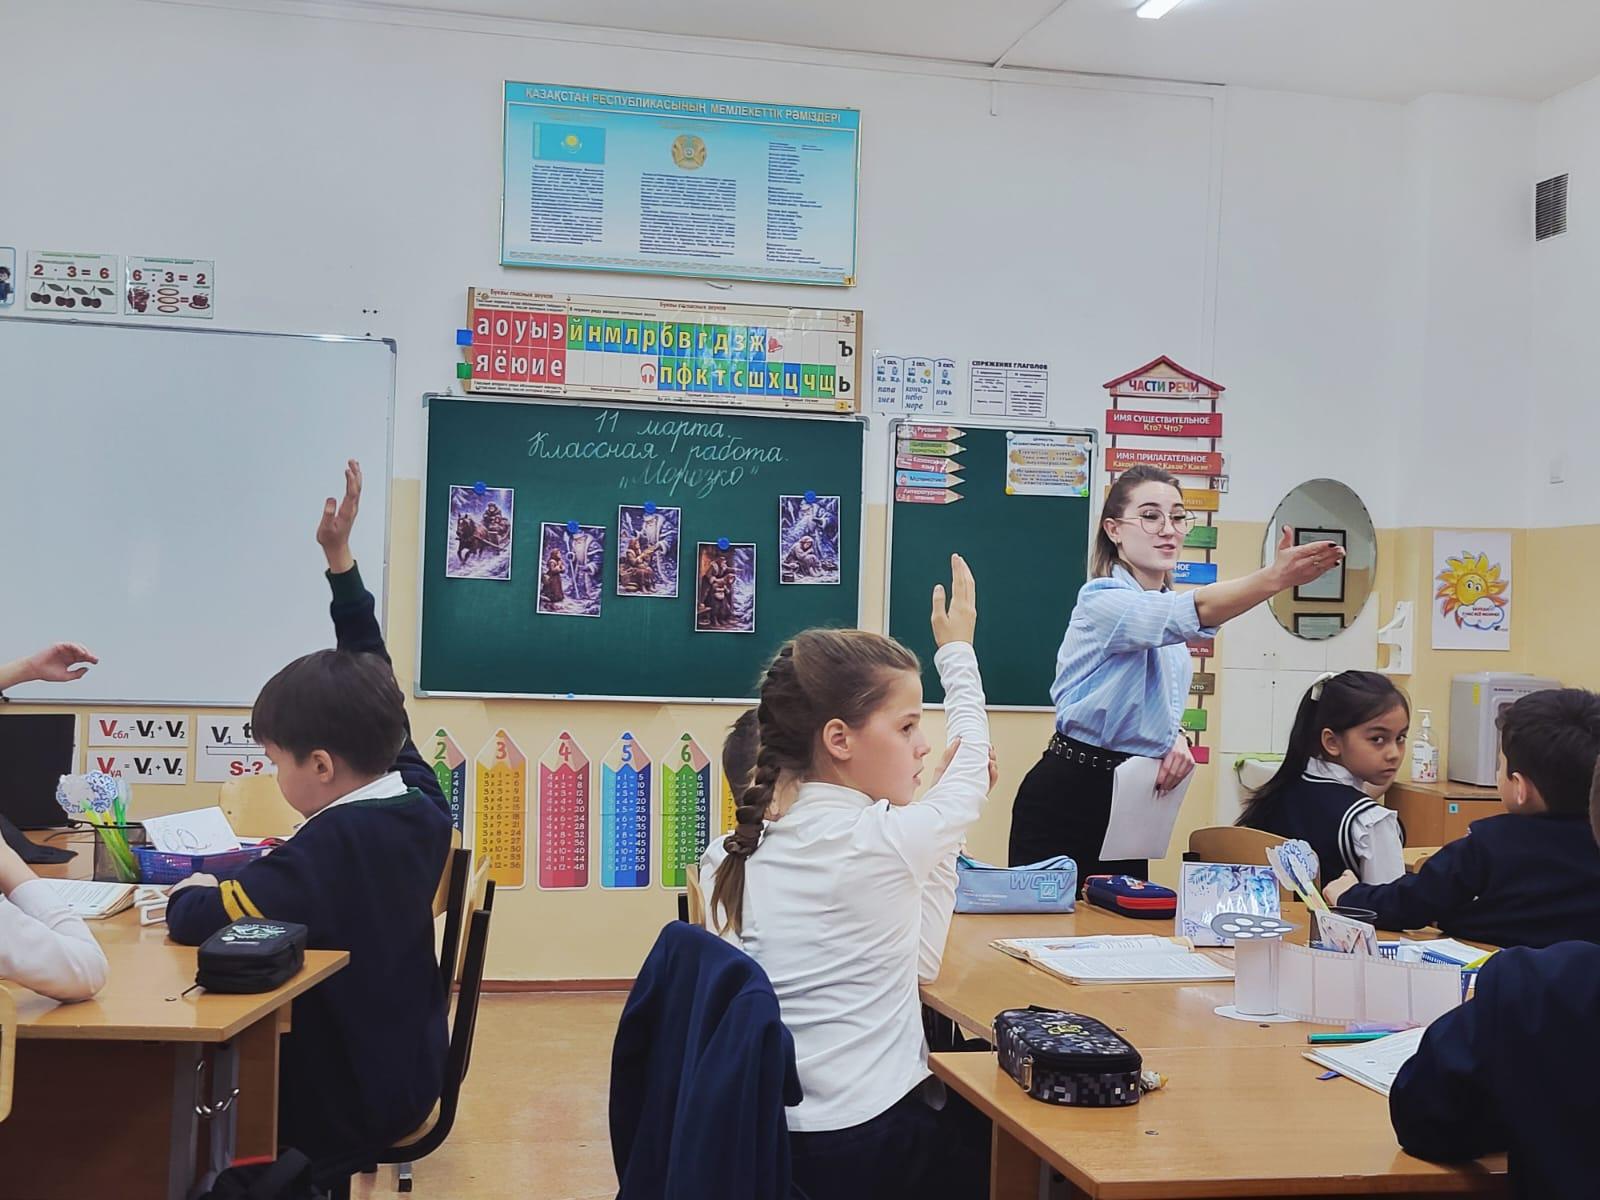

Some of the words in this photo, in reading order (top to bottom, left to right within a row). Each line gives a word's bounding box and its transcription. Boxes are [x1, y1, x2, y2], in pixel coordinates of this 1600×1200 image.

[592, 94, 706, 113] РЕСПУБЛИКАСЫНЫҢ
[711, 103, 783, 119] МЕМЛЕКЕТТІК
[785, 110, 840, 123] РӘМІЗДЕРІ
[34, 264, 44, 276] 2
[66, 266, 77, 277] 3
[100, 268, 110, 279] 6
[132, 270, 142, 281] 6
[164, 272, 174, 283] 3
[196, 274, 206, 285] 2
[477, 317, 490, 336] а
[496, 318, 509, 337] о
[514, 320, 528, 344] у
[531, 321, 548, 340] ы
[552, 322, 564, 340] э
[570, 318, 583, 342] й
[589, 326, 601, 342] н
[605, 327, 621, 344] м
[625, 328, 638, 346] л
[642, 328, 656, 352] р
[660, 324, 674, 348] б
[678, 332, 691, 349] в
[698, 332, 708, 350] г
[714, 333, 729, 354] д
[734, 334, 746, 352] з
[750, 335, 764, 352] ж
[476, 354, 489, 372] я
[494, 350, 507, 373] ё
[511, 356, 528, 374] ю
[532, 358, 544, 376] и
[550, 358, 563, 377] е
[660, 366, 672, 384] п
[676, 362, 692, 391] ф
[696, 368, 708, 385] к
[716, 369, 726, 386] т
[734, 370, 743, 387] с
[749, 372, 764, 388] ш
[768, 372, 780, 389] х
[784, 373, 798, 394] ц
[804, 374, 815, 391] ч
[819, 375, 835, 396] щ
[1129, 380, 1166, 392] ЧАСТИ
[1168, 381, 1199, 393] РЕЧИ
[595, 410, 618, 433] 11
[1134, 414, 1210, 424] СУЩЕСТВИТЕЛЬНОЕ
[1144, 424, 1162, 432] Кто?
[528, 432, 658, 460] Классная
[1116, 452, 1134, 460] ИМЯ
[1136, 453, 1207, 462] ПРИЛАГАТЕЛЬНОЕ
[434, 742, 447, 760] 2
[496, 742, 506, 760] 3
[558, 742, 572, 762] 4
[621, 744, 632, 762] 5
[680, 744, 692, 762] 6
